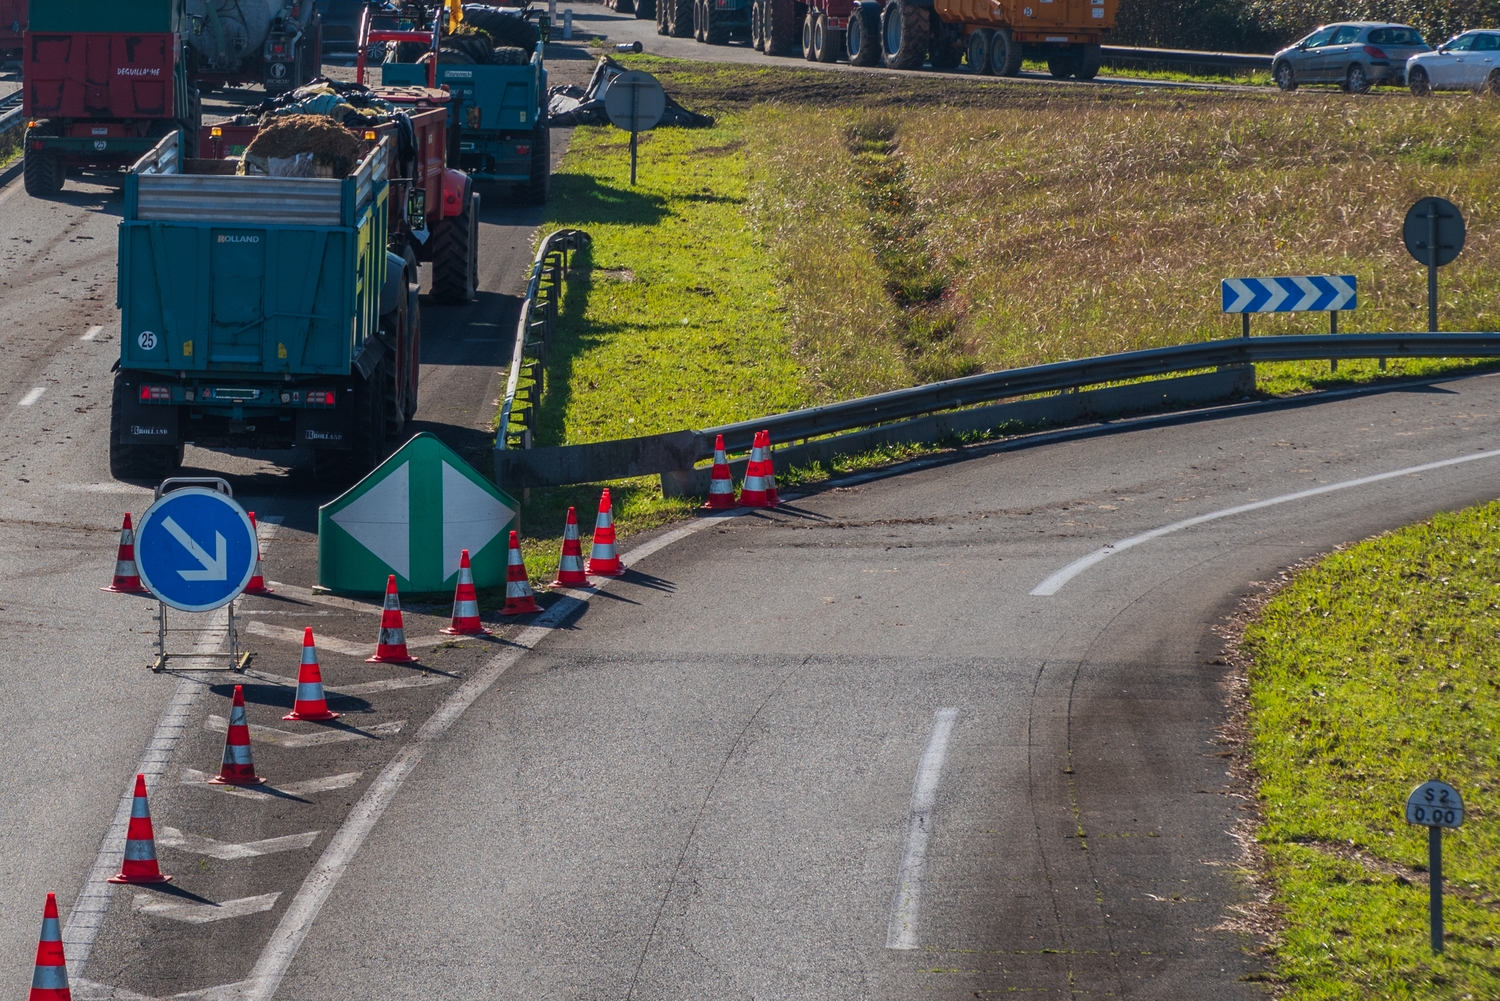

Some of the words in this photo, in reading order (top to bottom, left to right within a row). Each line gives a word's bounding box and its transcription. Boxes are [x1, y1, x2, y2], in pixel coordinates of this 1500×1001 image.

[117, 67, 160, 76] DEGUILLAME
[216, 234, 260, 244] ROLLAND
[141, 332, 154, 349] 25
[1424, 787, 1435, 802] S
[1439, 789, 1450, 803] 2
[1414, 807, 1456, 824] 0.00
